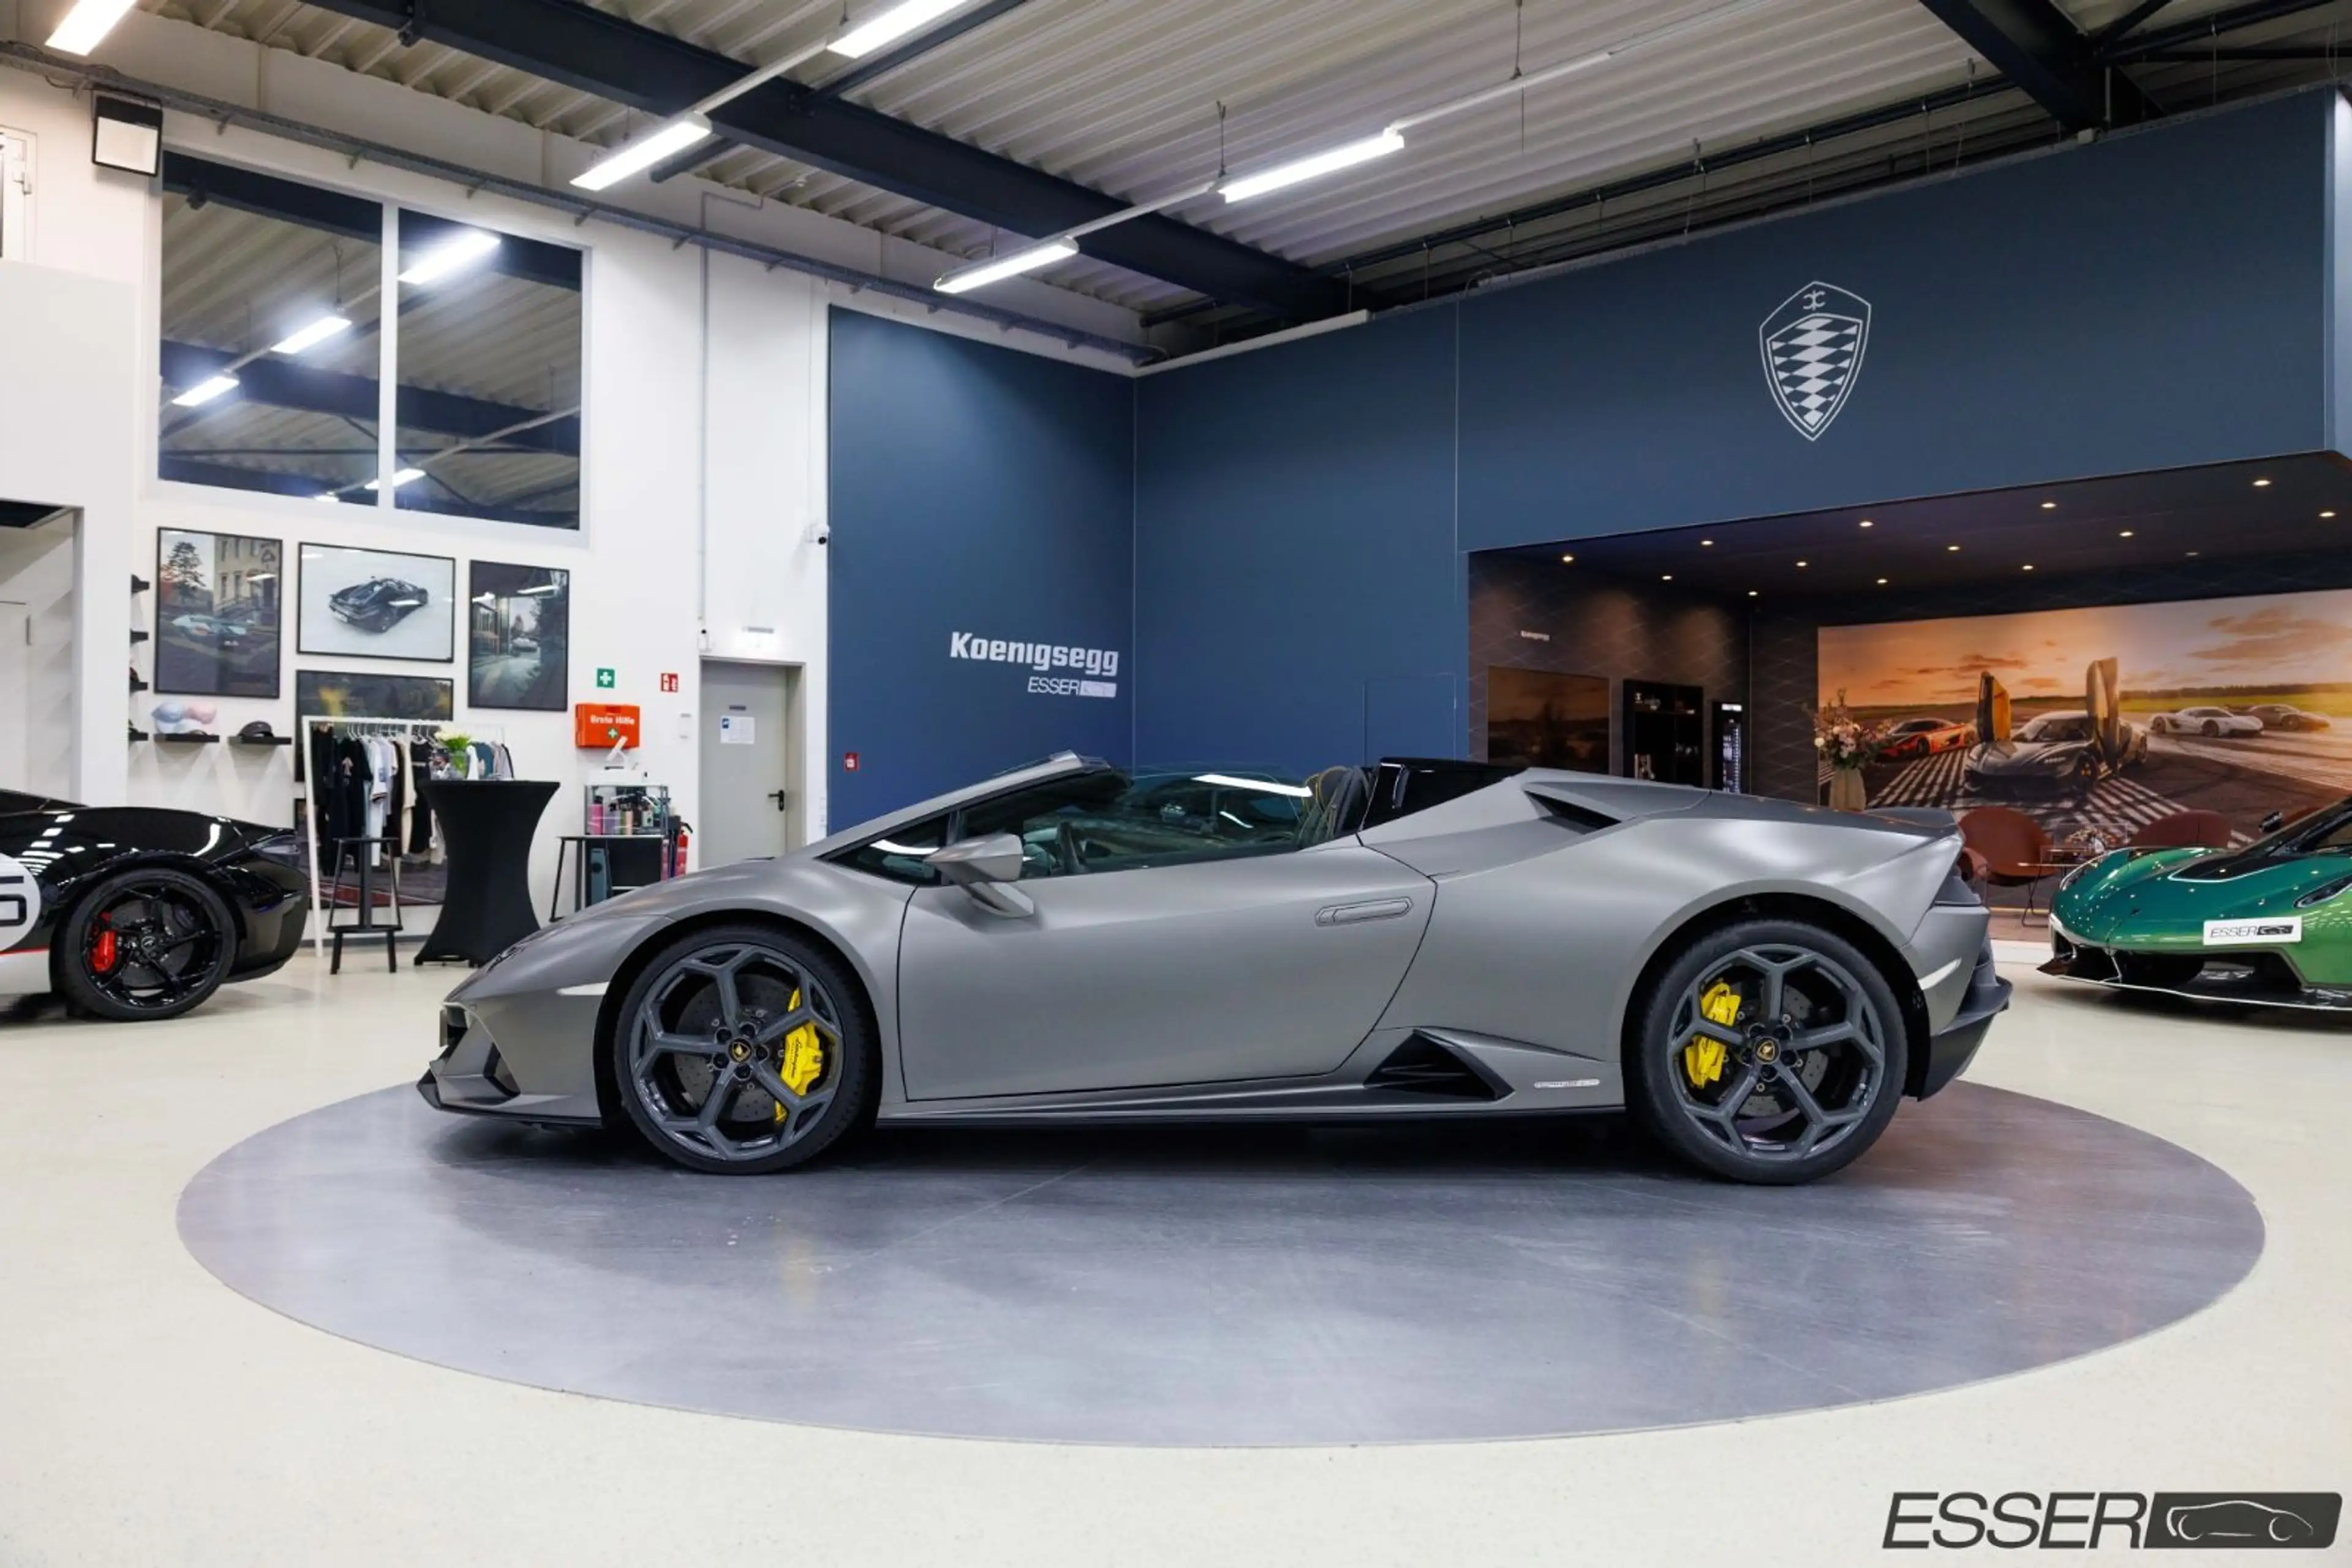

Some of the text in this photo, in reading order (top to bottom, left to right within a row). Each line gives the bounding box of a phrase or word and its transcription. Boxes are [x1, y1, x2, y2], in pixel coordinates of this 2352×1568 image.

[950, 631, 1119, 677] Koenigsegg
[1027, 676, 1080, 696] ESSER
[2210, 925, 2257, 938] ESSER
